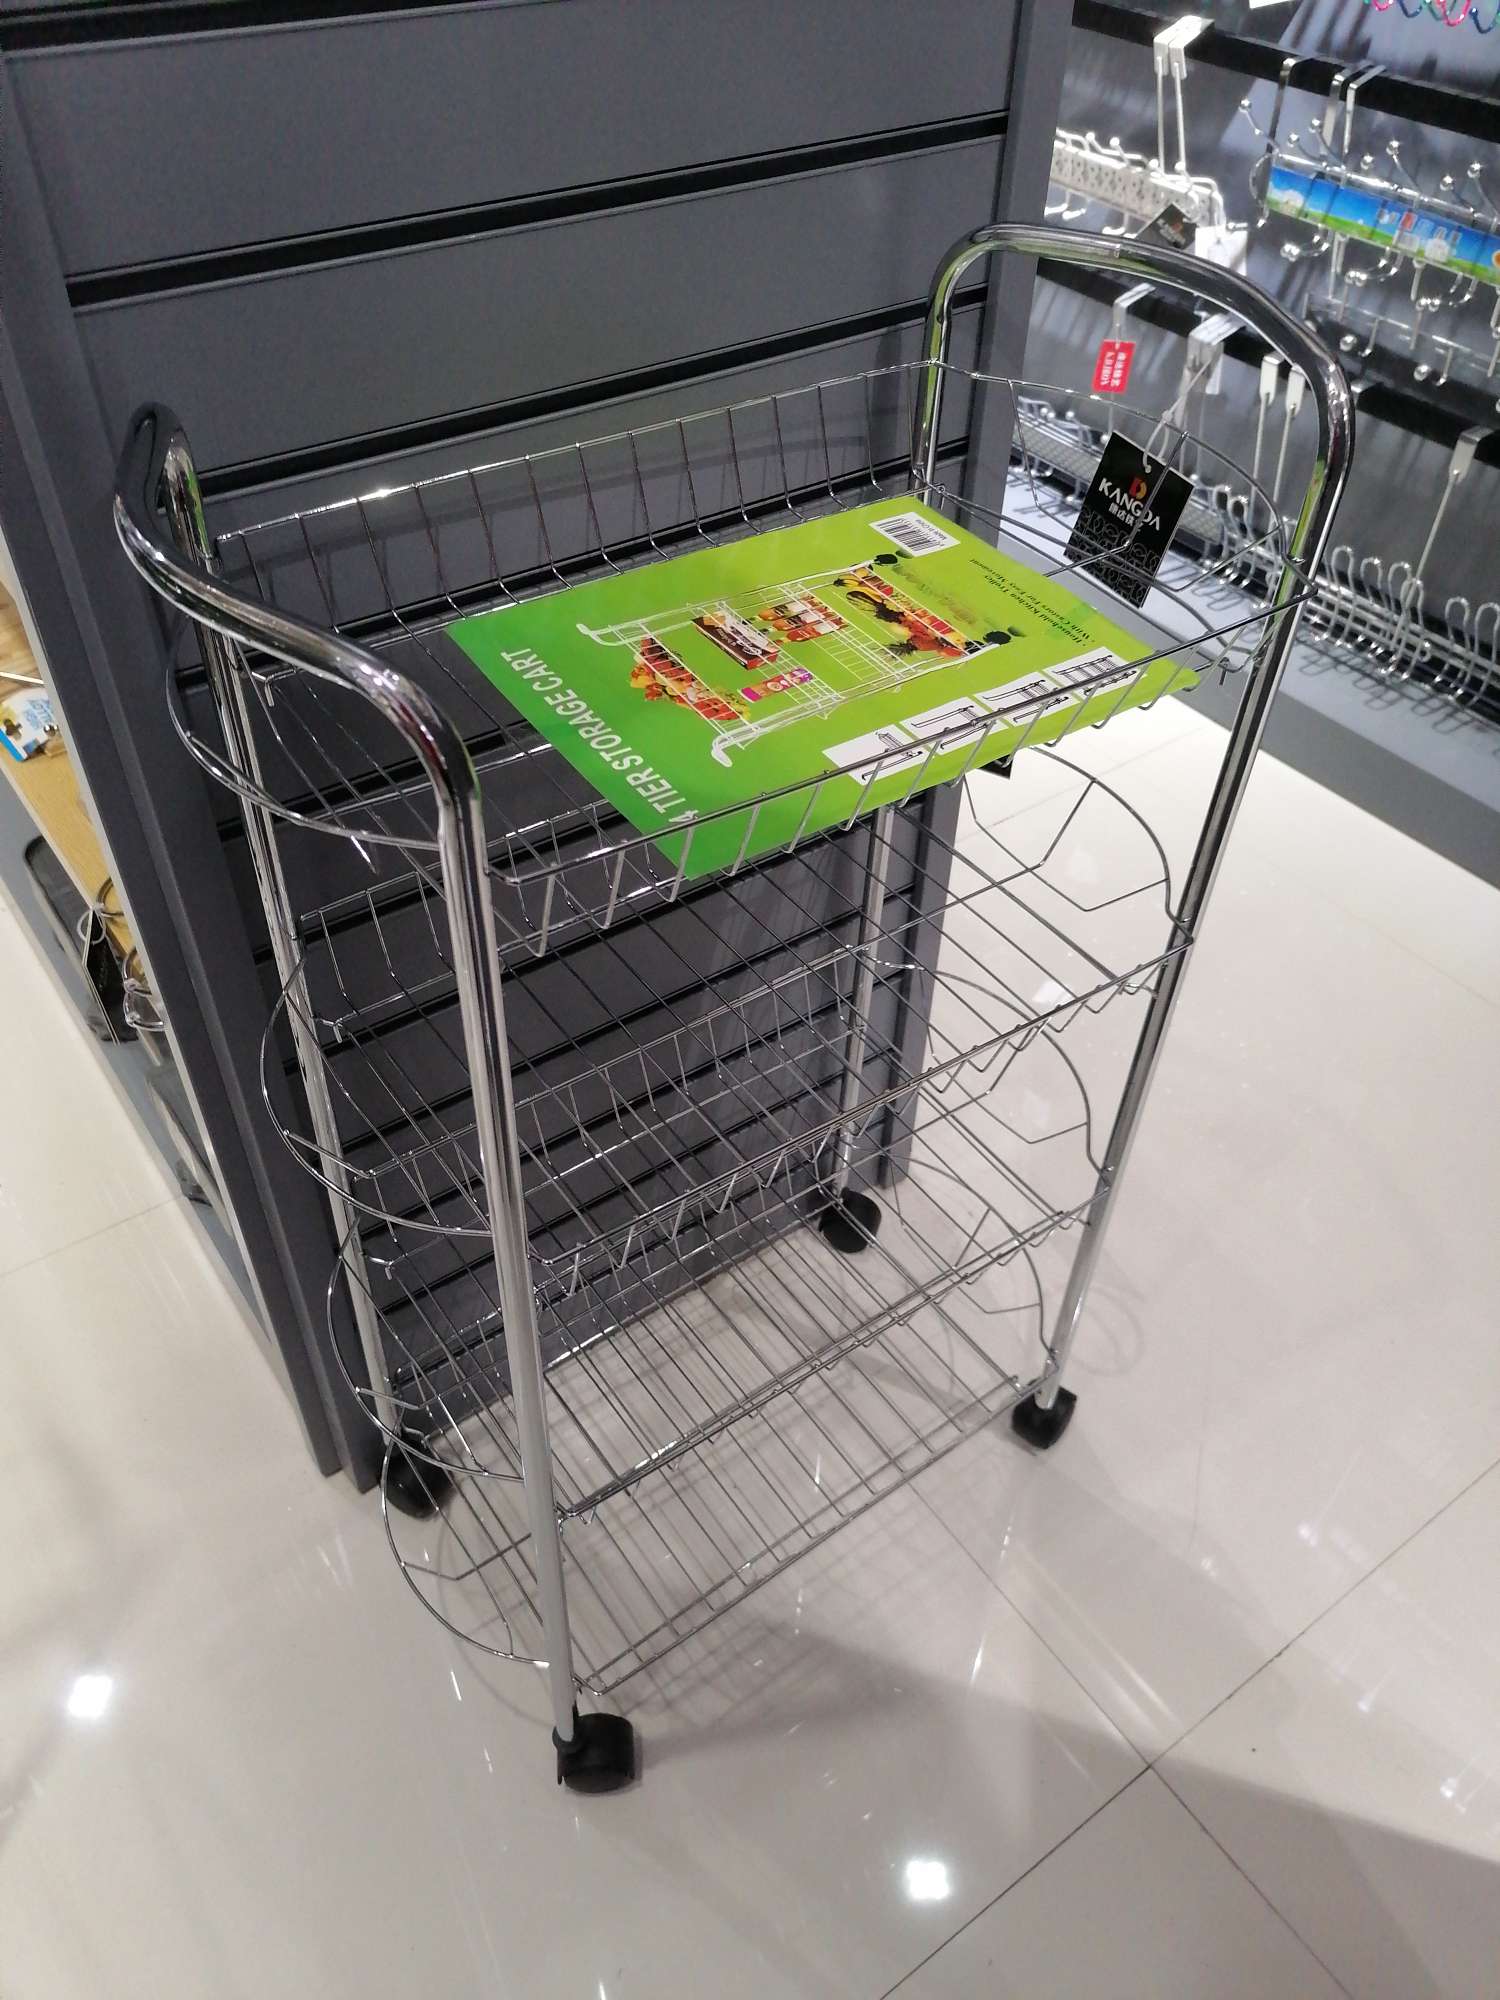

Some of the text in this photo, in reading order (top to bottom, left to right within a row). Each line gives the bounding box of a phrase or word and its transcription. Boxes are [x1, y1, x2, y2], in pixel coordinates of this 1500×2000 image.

[501, 648, 563, 692] CART
[544, 689, 644, 771] STORAGE
[626, 768, 686, 813] TIER
